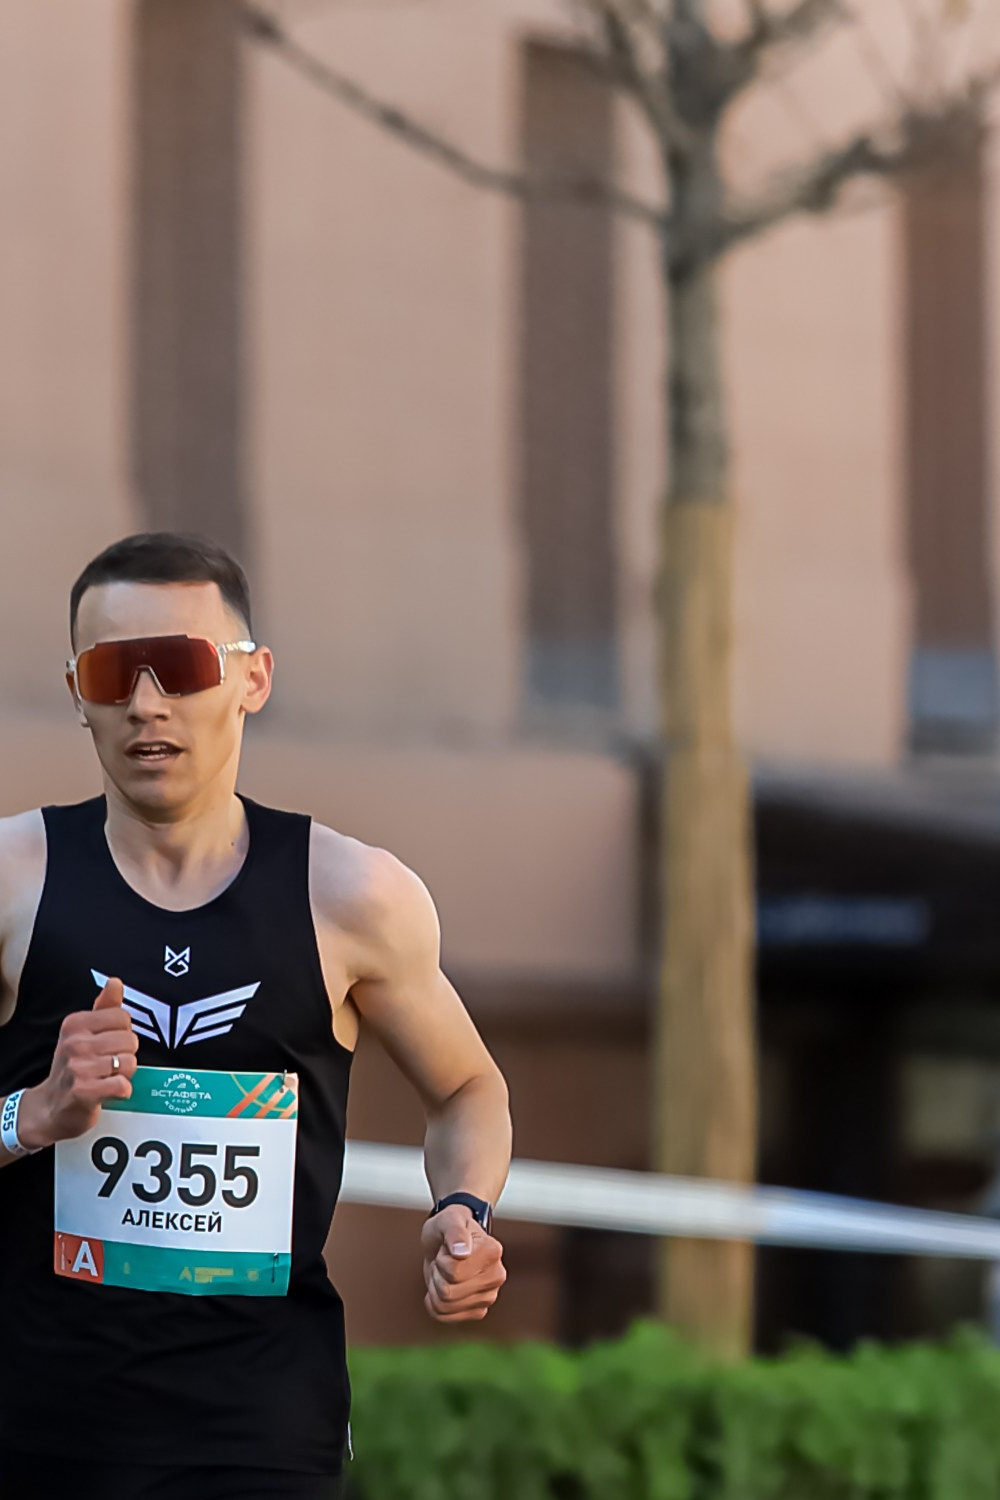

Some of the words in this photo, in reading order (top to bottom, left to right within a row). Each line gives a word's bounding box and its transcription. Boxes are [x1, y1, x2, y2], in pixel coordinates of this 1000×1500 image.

[2, 1093, 20, 1132] 9355
[91, 1136, 261, 1208] 9355
[121, 1208, 222, 1233] АЛЕКСЕЙ
